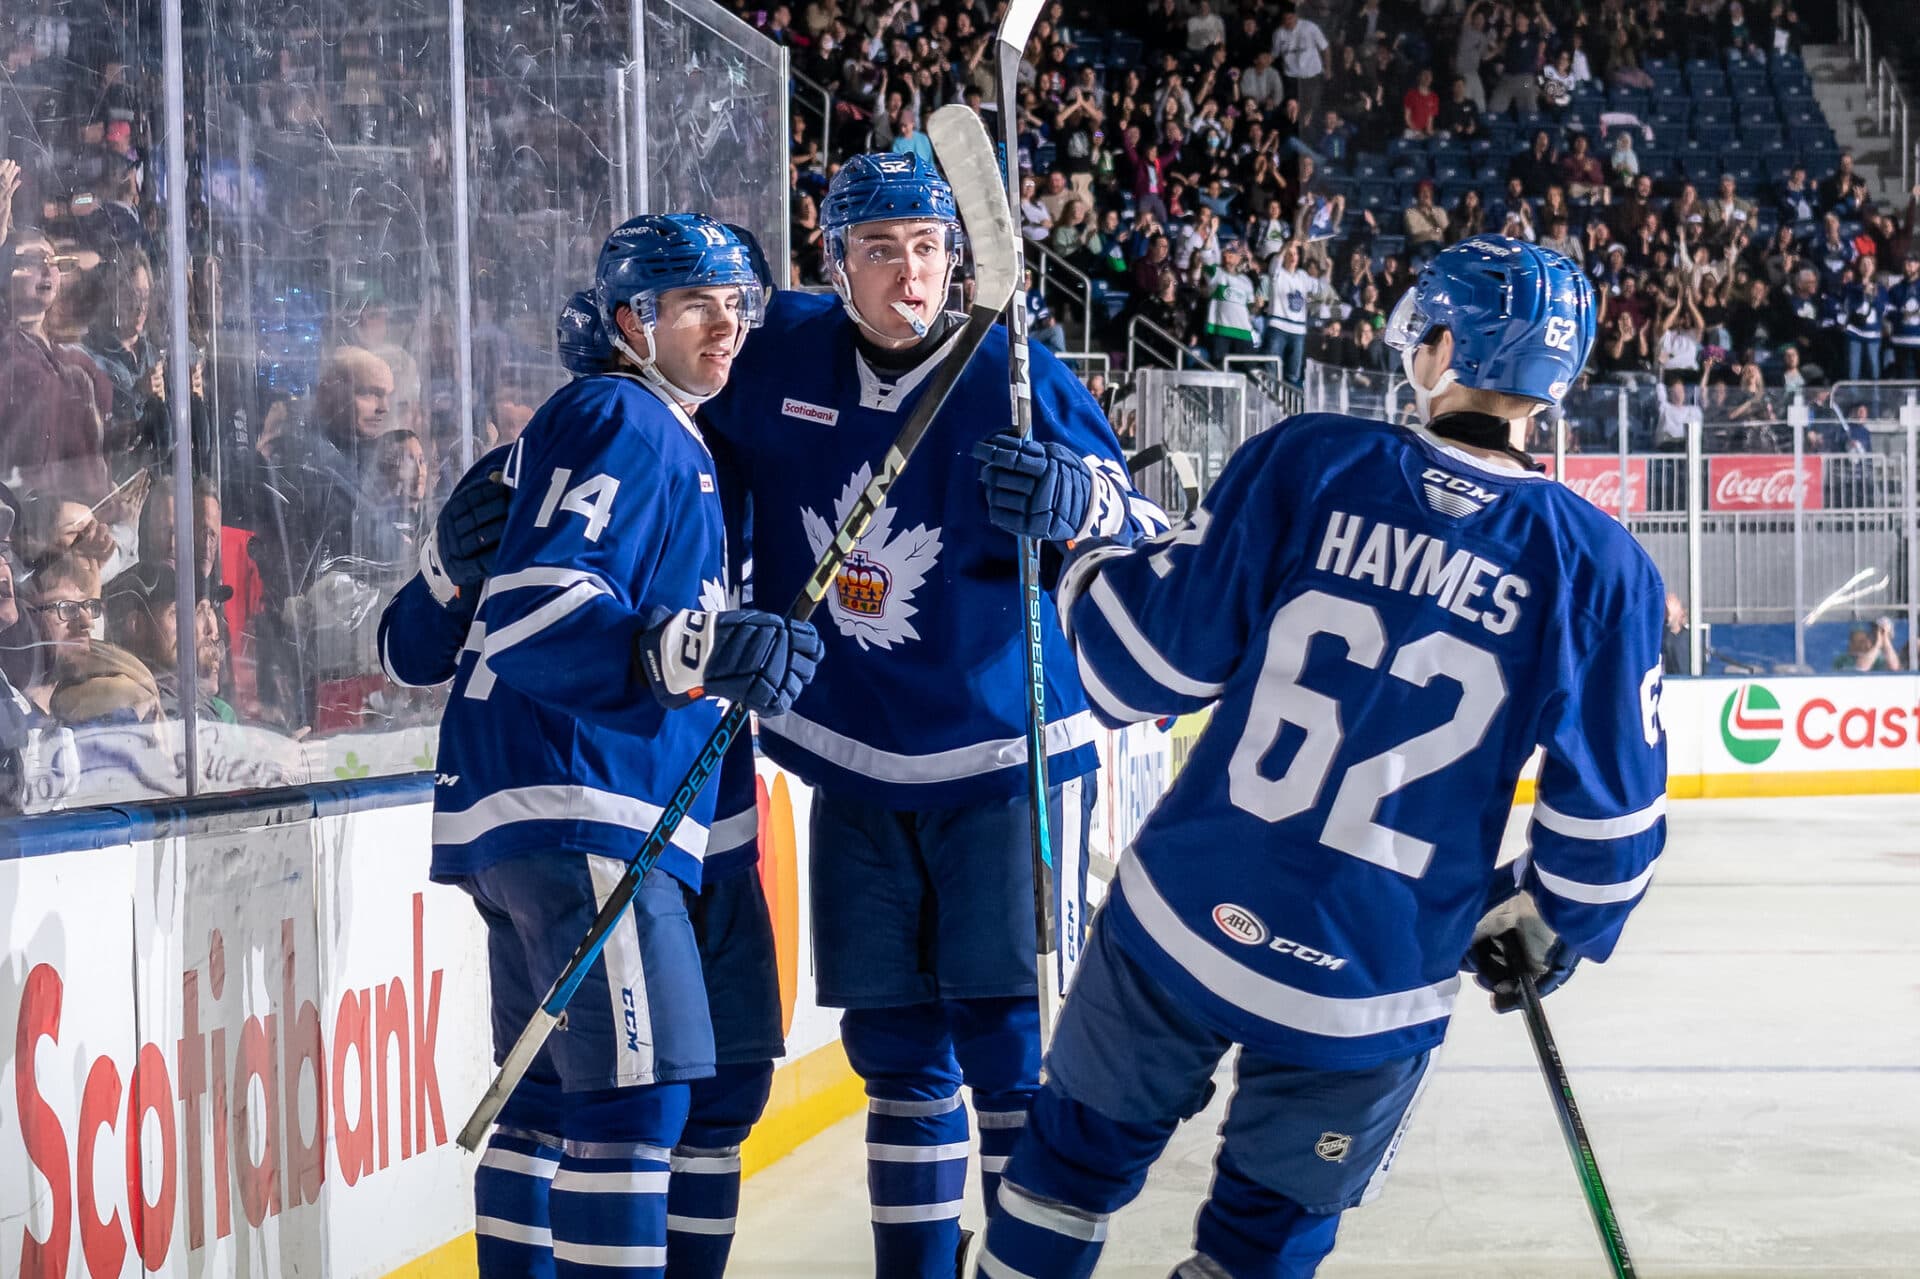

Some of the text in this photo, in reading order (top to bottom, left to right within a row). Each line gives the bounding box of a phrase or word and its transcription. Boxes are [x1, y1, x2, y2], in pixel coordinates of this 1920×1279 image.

[880, 160, 910, 173] 52
[1544, 316, 1577, 352] 62
[785, 402, 834, 422] Scotiabank
[534, 466, 621, 543] 14
[1421, 468, 1500, 504] CCM
[805, 444, 907, 602] CCM
[1315, 511, 1531, 636] HAYMES
[1228, 589, 1510, 879] 62
[630, 729, 731, 892] JETSPEED
[1067, 899, 1077, 962] CCM
[1222, 913, 1253, 937] AHL
[1268, 935, 1349, 971] CCM
[621, 986, 640, 1053] CCM
[15, 892, 448, 1279] Scotiabank
